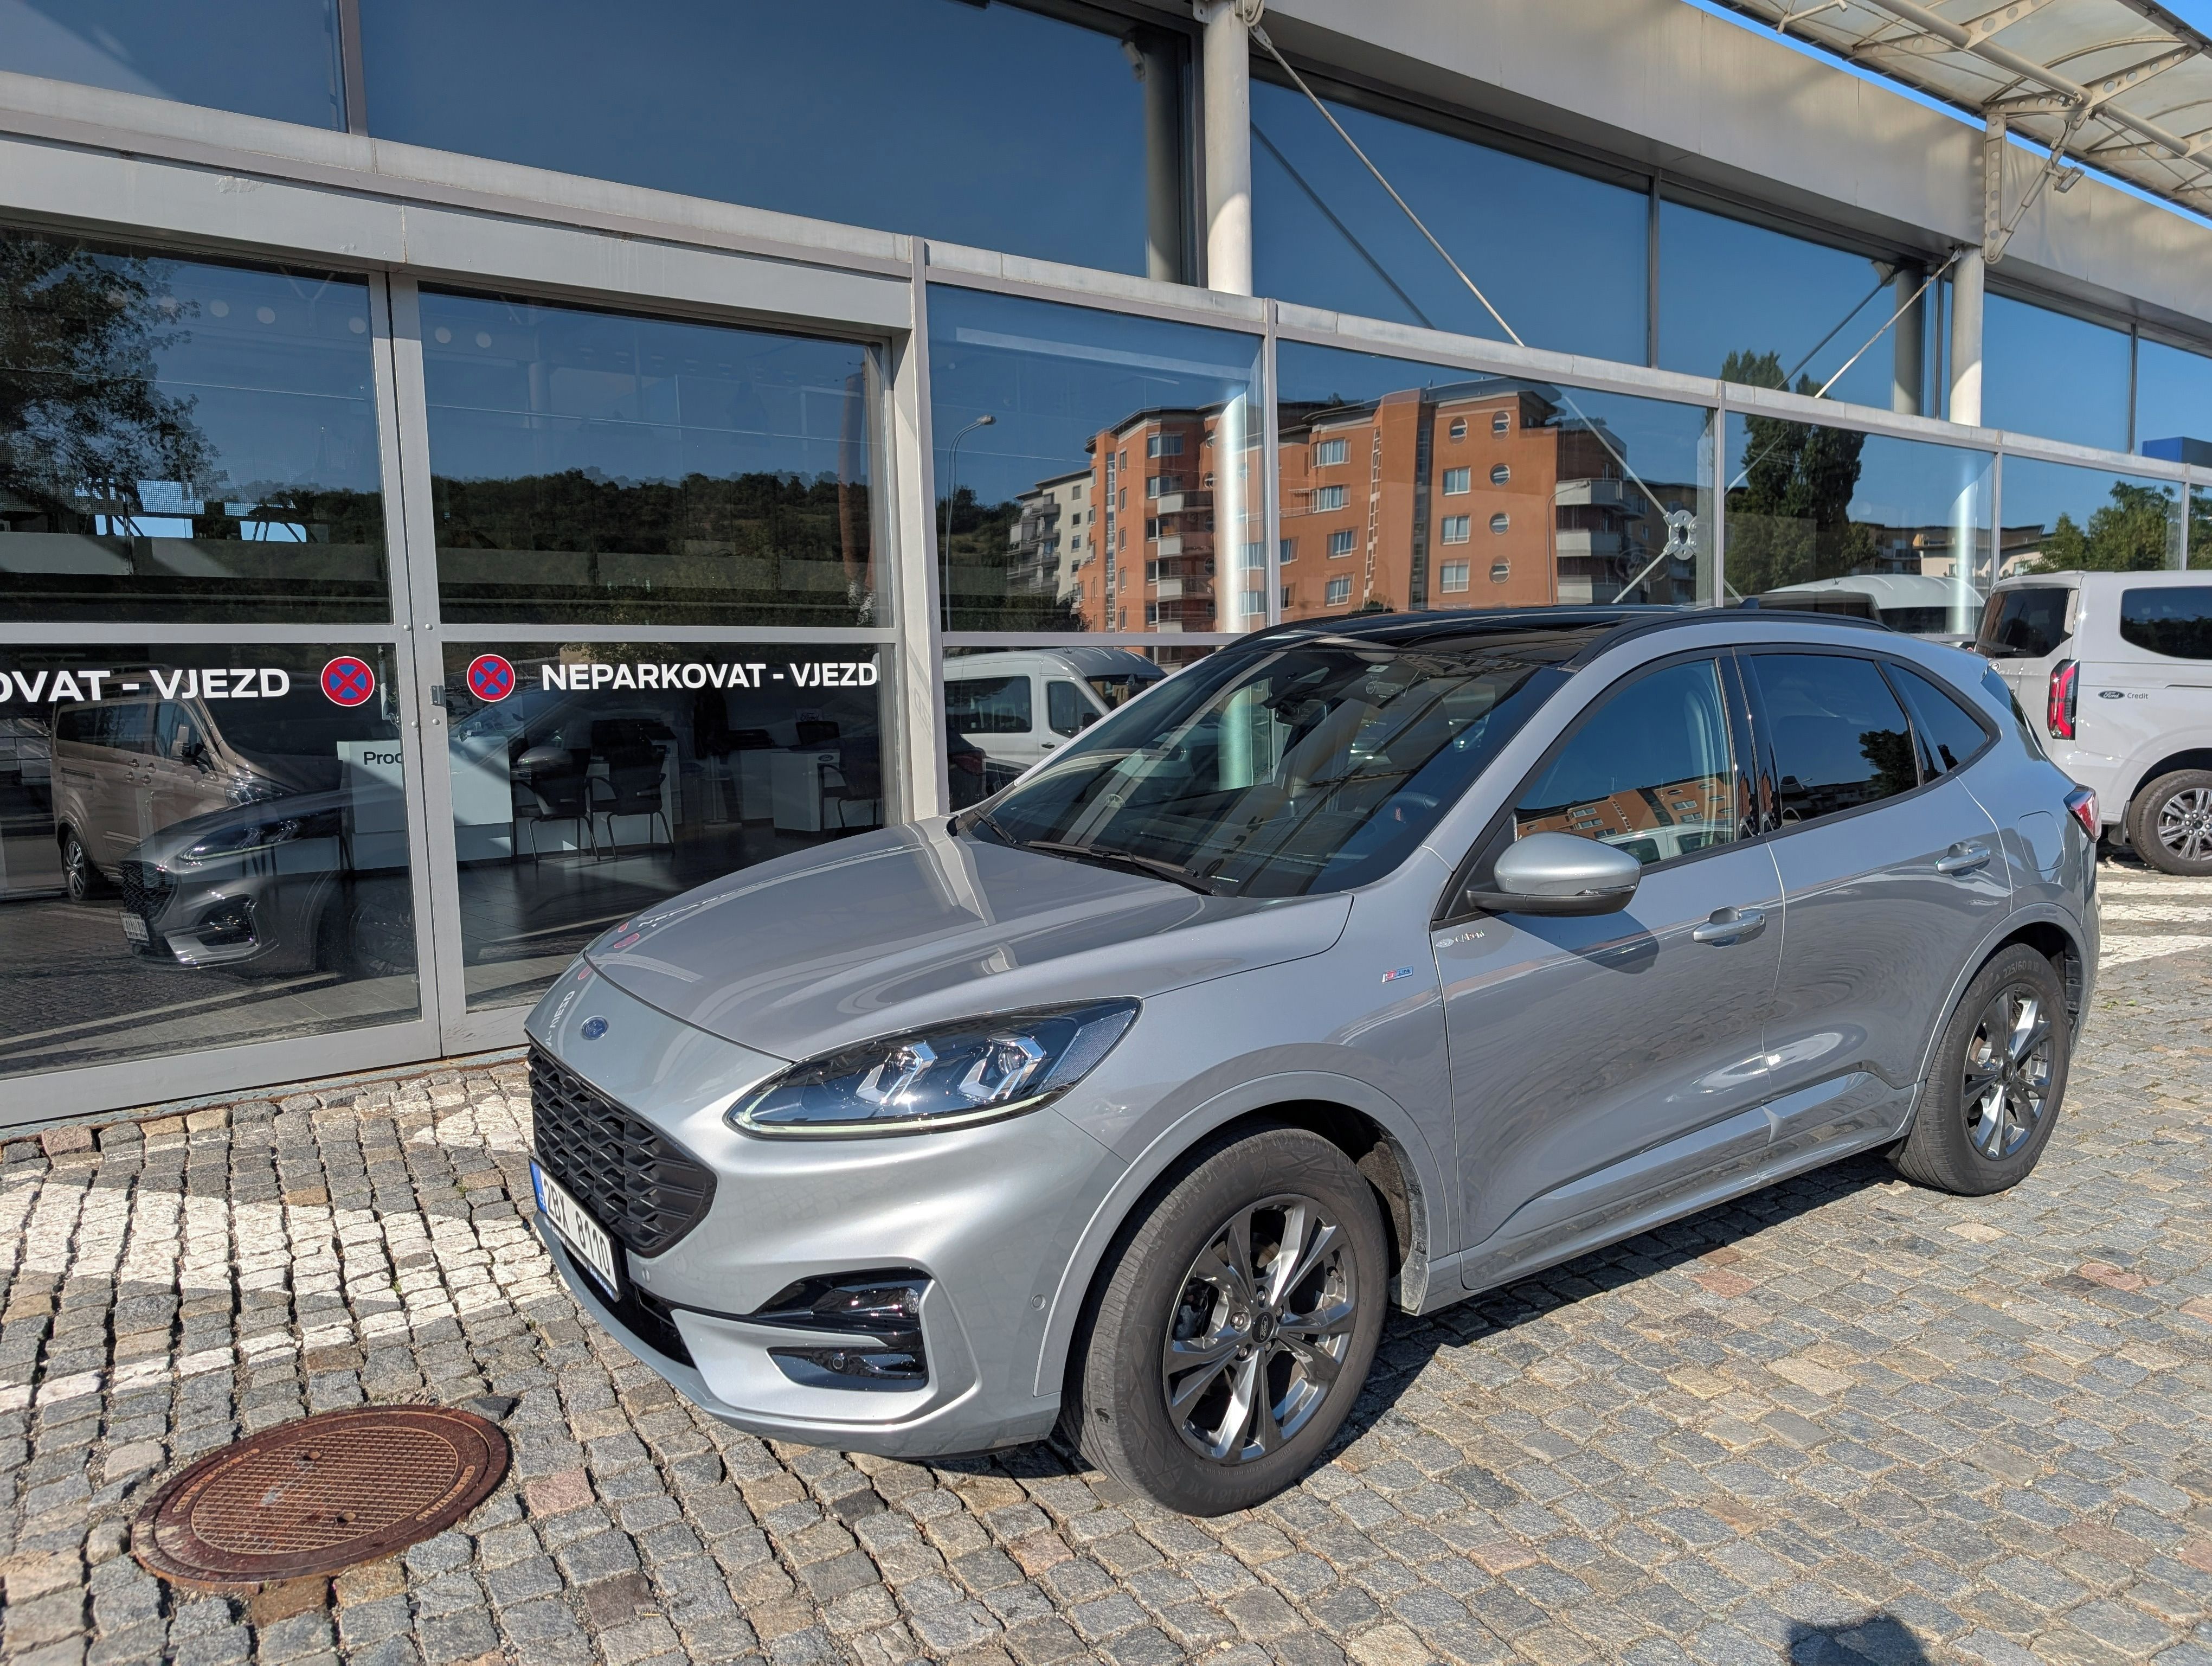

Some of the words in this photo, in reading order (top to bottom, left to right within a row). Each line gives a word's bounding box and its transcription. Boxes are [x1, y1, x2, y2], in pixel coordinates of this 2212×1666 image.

[149, 668, 290, 700] VJEZD
[542, 663, 766, 690] NEPARKOVAT
[789, 662, 878, 687] VJEZD
[2101, 691, 2122, 700] Ford
[543, 1178, 570, 1234] 2BX
